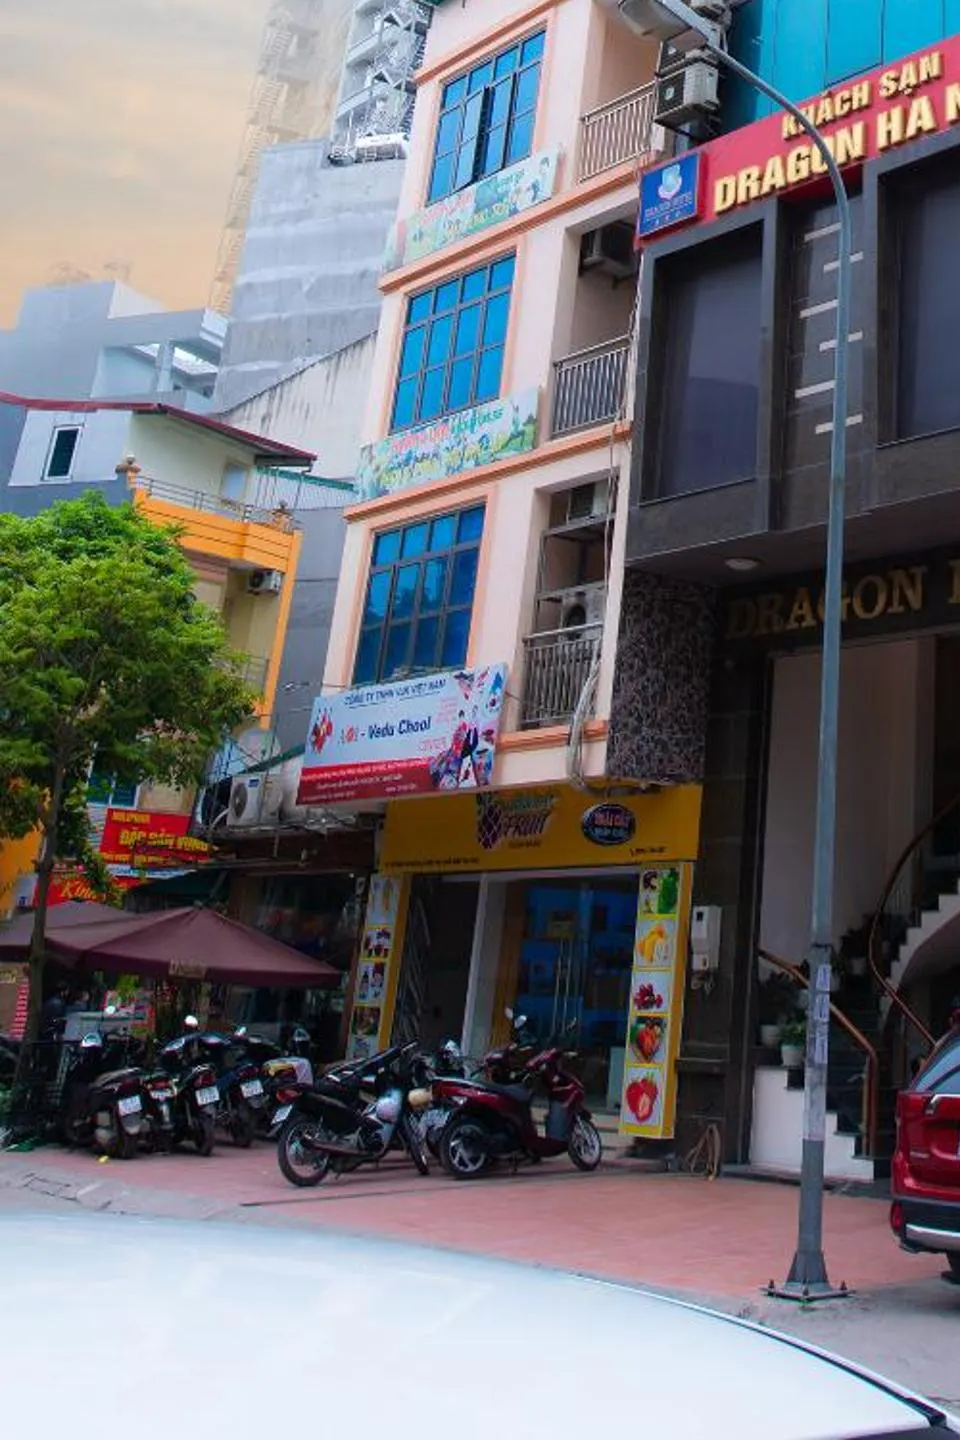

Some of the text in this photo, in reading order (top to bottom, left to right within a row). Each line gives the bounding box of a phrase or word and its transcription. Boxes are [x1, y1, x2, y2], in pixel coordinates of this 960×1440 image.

[879, 50, 943, 99] SẠN
[713, 120, 866, 215] DRAGON
[876, 95, 937, 150] HA
